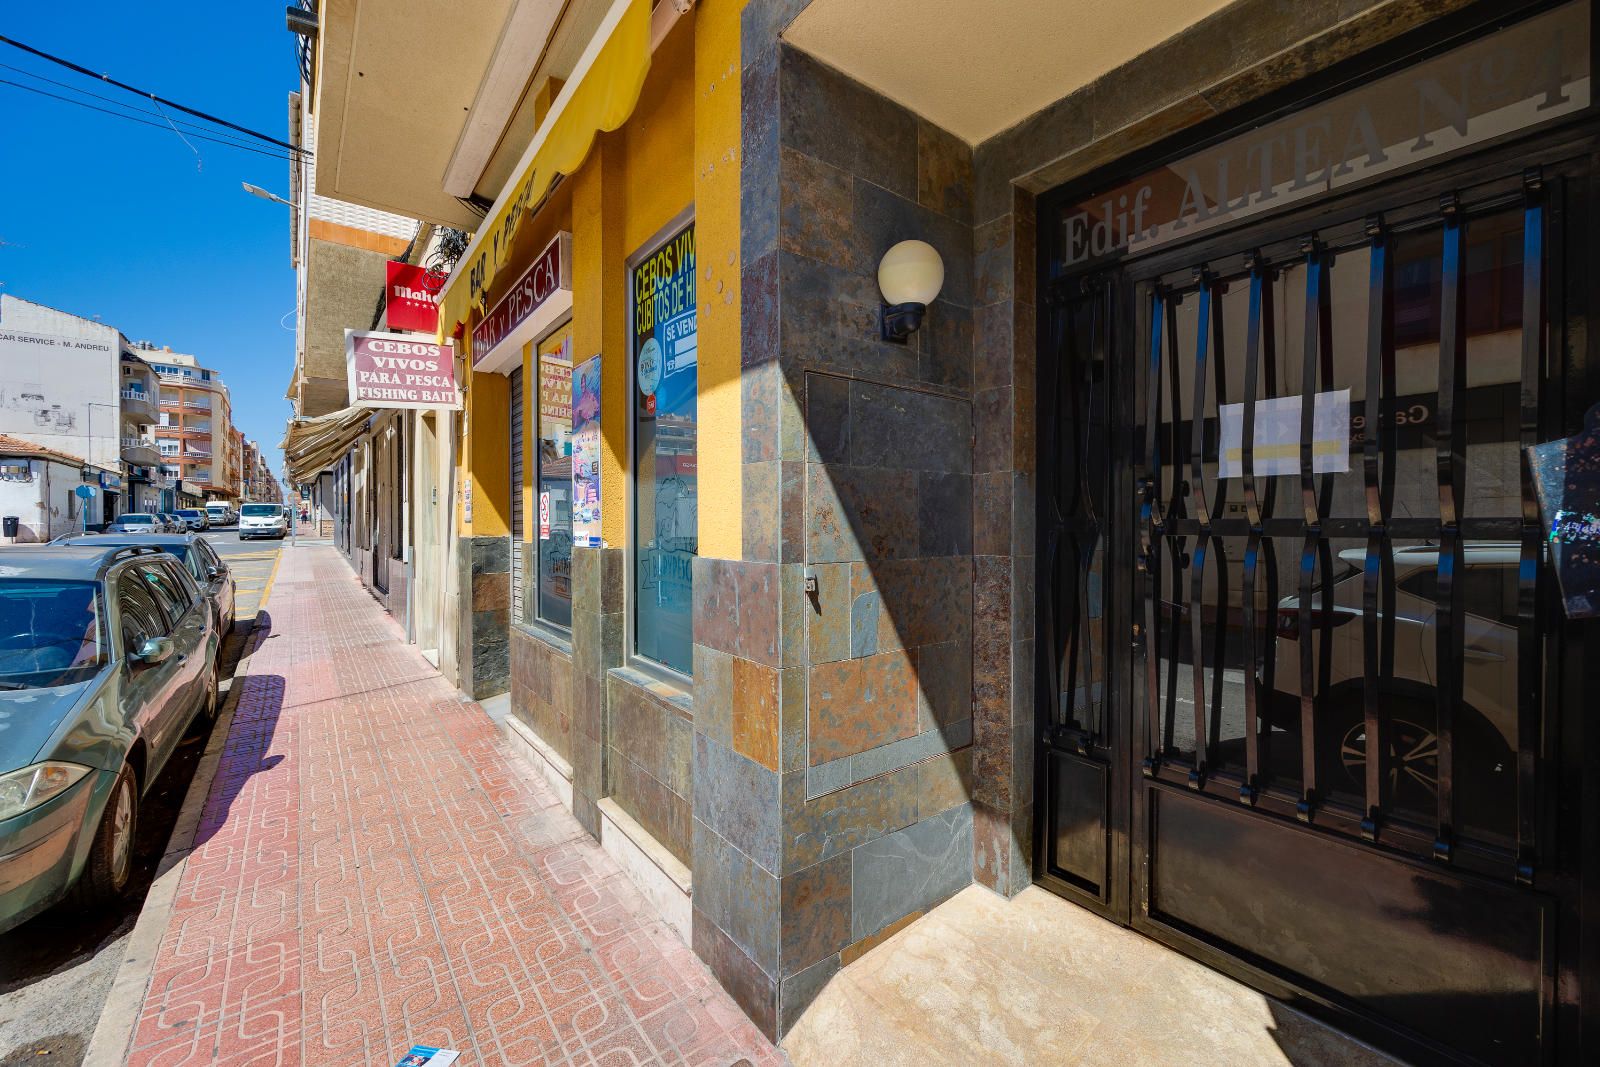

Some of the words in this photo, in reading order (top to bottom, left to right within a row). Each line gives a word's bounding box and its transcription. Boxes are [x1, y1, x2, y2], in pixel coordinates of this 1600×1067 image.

[1062, 185, 1160, 267] Edif.
[1172, 103, 1390, 230] ALTEA
[470, 250, 487, 299] BAR
[635, 244, 673, 305] CEBOS
[476, 315, 497, 361] BAR
[507, 252, 556, 331] PESCA
[636, 286, 670, 336] CUBITOS
[672, 275, 684, 317] DE
[666, 323, 676, 342] SE
[17, 335, 56, 346] SERVICE
[74, 342, 110, 352] ANDREU
[367, 340, 441, 357] CEBOS
[371, 356, 439, 372] VIVOS
[359, 371, 402, 385] PARA
[405, 374, 452, 388] PESCA
[358, 386, 418, 401] FISHING
[421, 390, 454, 402] BAIT
